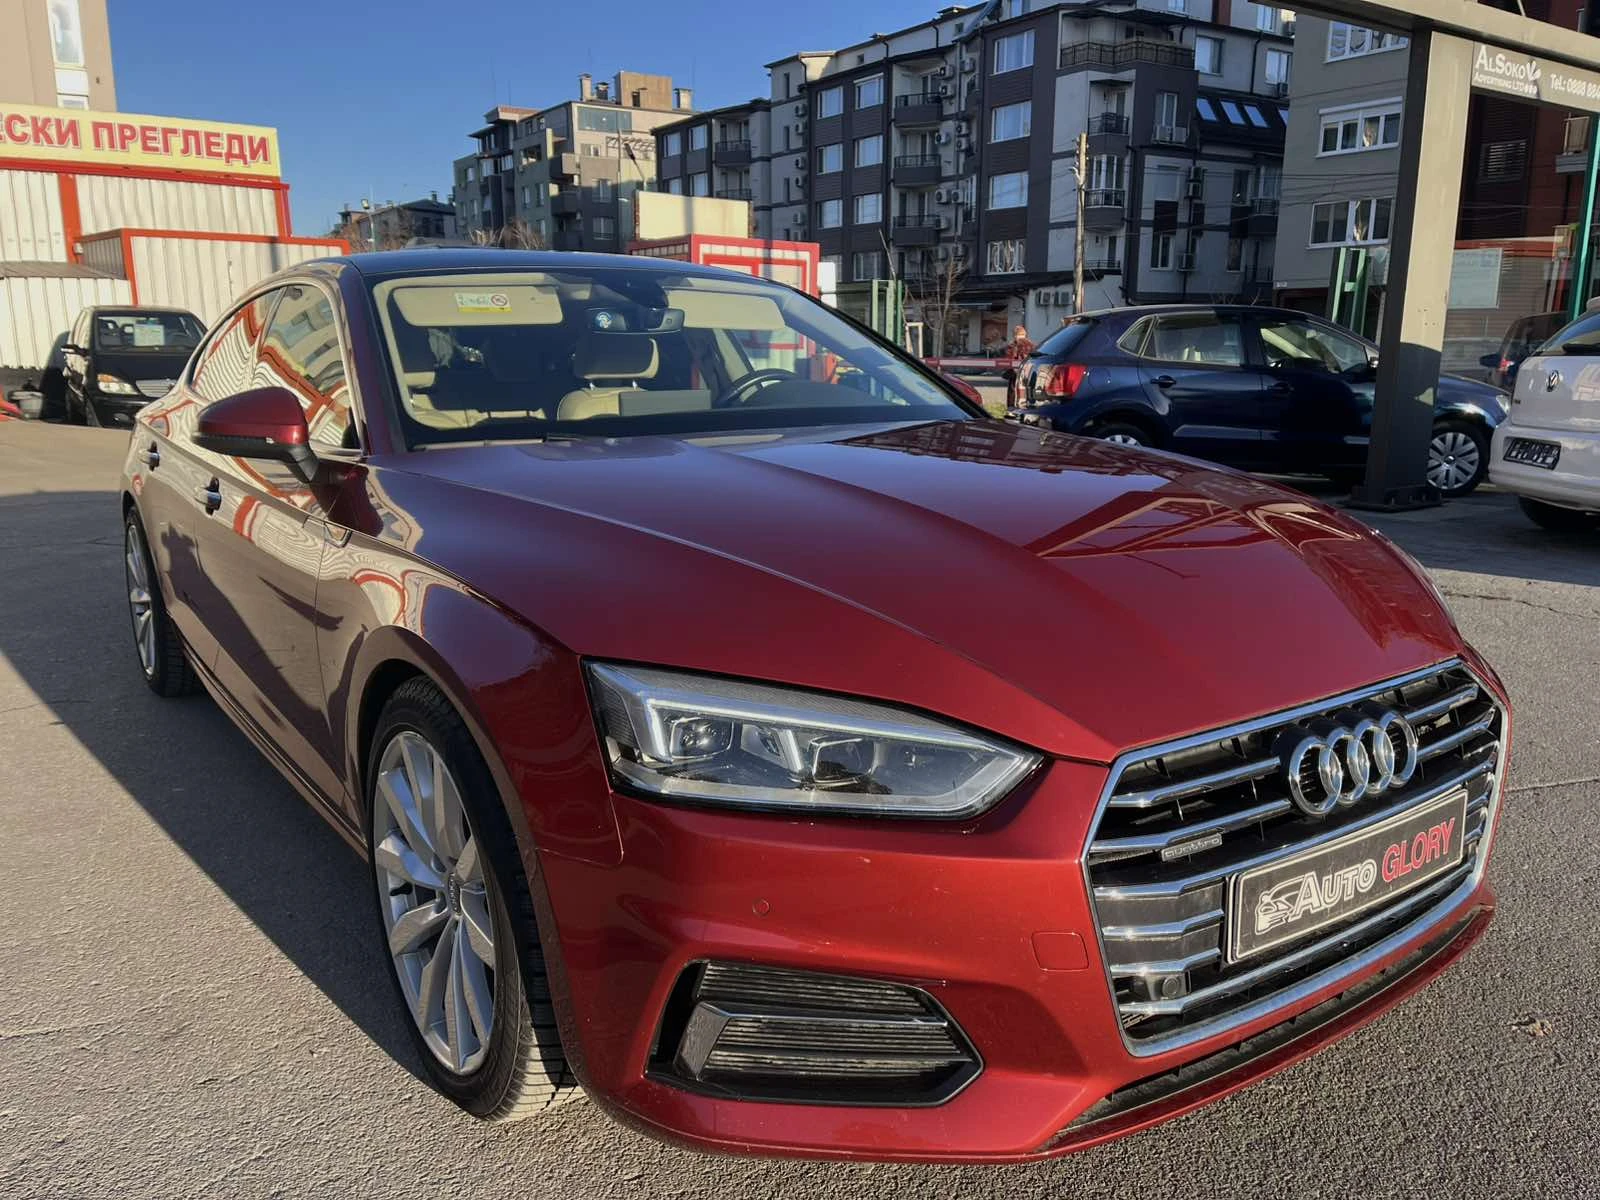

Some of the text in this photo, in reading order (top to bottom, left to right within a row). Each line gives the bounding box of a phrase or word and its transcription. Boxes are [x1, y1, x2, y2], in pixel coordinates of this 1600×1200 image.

[0, 112, 271, 166] СКИ ПРЕГЛЕДИ
[1165, 838, 1220, 857] quattro
[1382, 817, 1456, 883] GLORY
